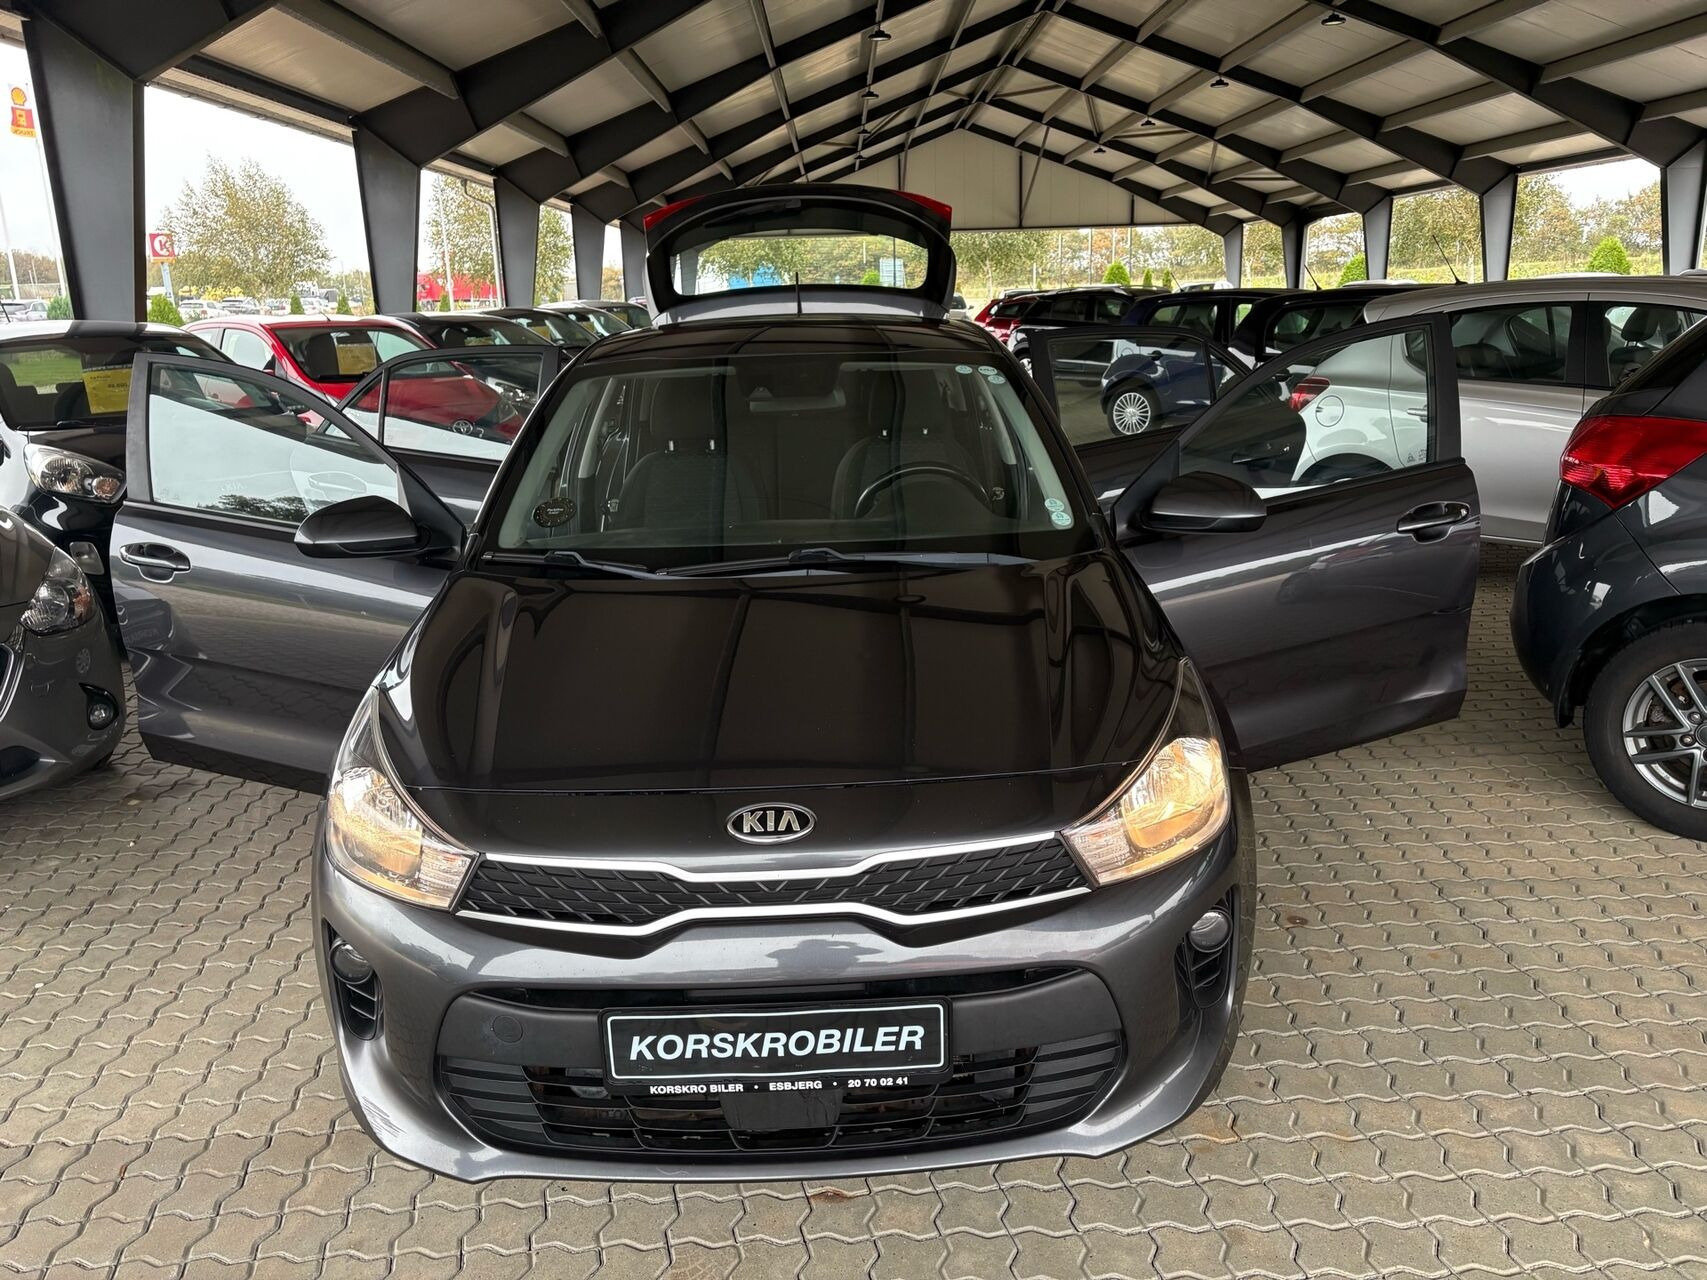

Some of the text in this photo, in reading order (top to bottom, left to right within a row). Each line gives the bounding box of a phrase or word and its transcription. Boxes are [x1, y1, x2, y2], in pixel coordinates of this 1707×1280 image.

[743, 810, 801, 833] KIA
[630, 1025, 925, 1061] KORSKROBILER
[649, 1076, 908, 1095] KORSKRO BILER ESBJERG 20 70 02 41
